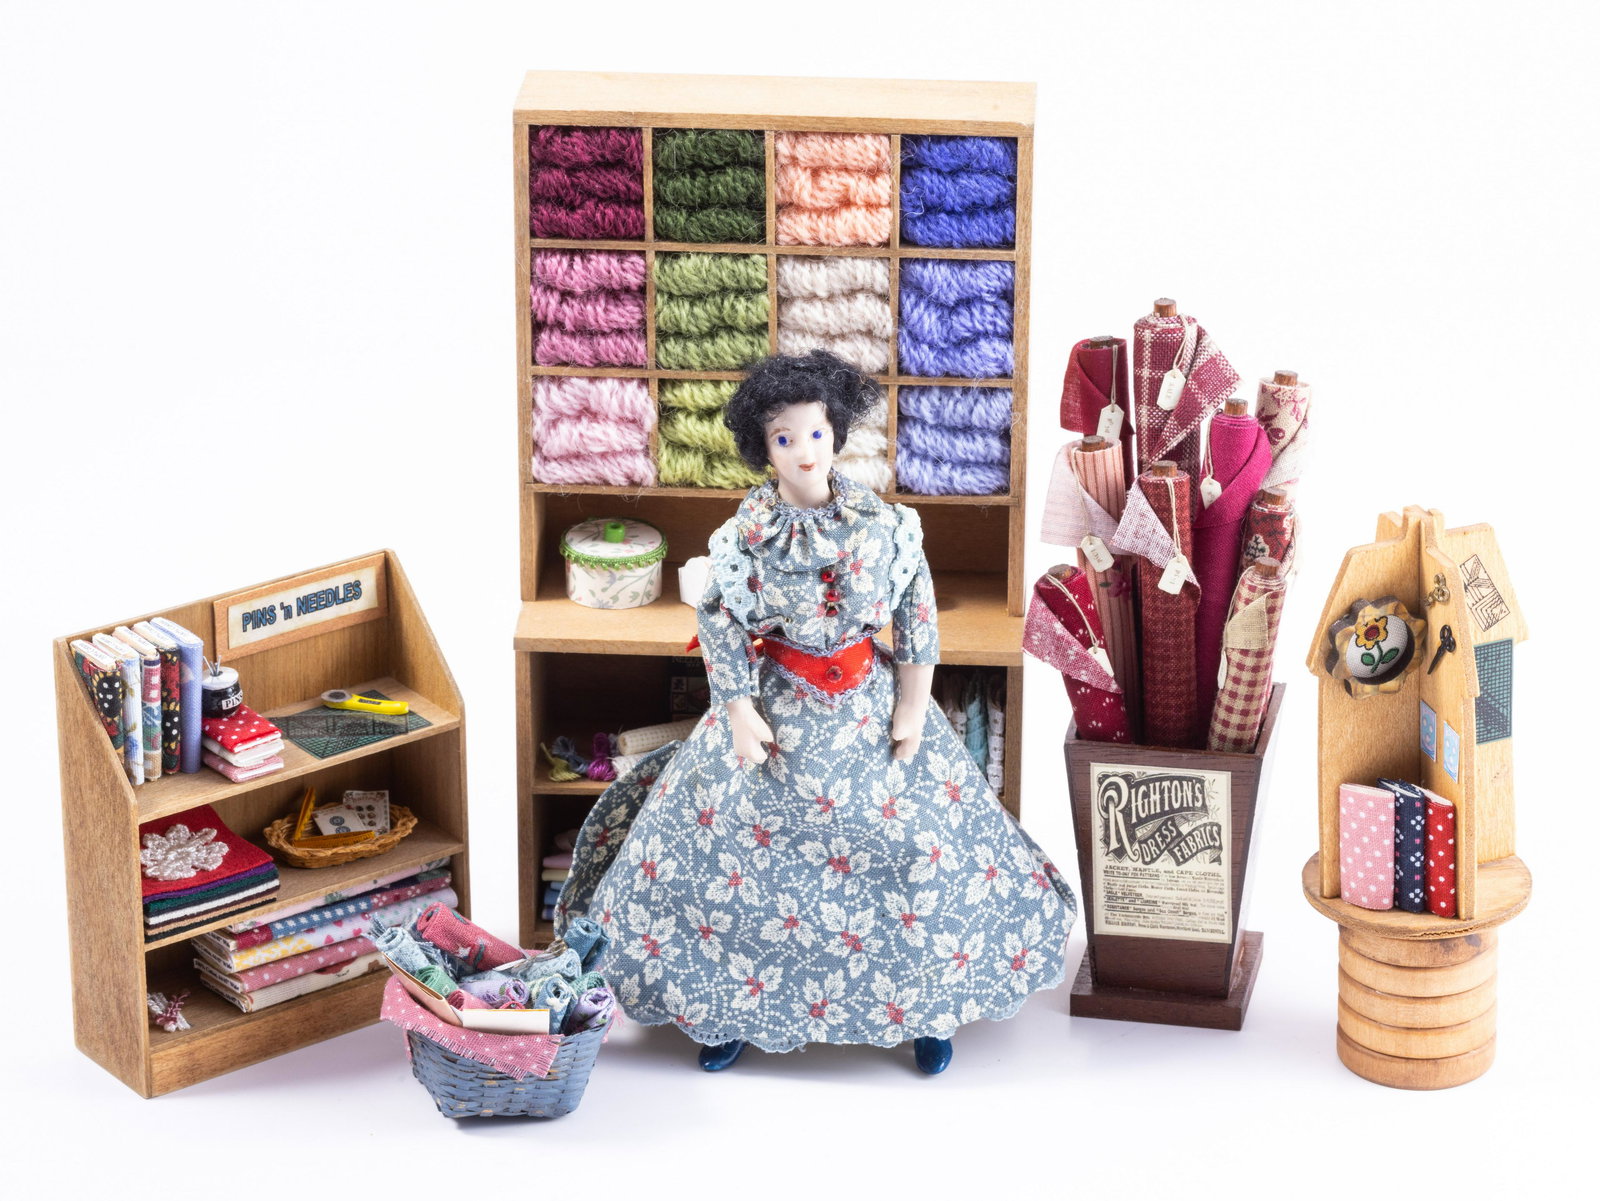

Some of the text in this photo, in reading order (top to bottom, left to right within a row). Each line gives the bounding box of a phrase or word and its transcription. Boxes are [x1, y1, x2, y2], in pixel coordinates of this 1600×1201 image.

[241, 580, 362, 632] PINS 'n NEEDLES
[1098, 775, 1203, 862] RIGHTON'S
[1141, 820, 1220, 863] DRESS FABRICS
